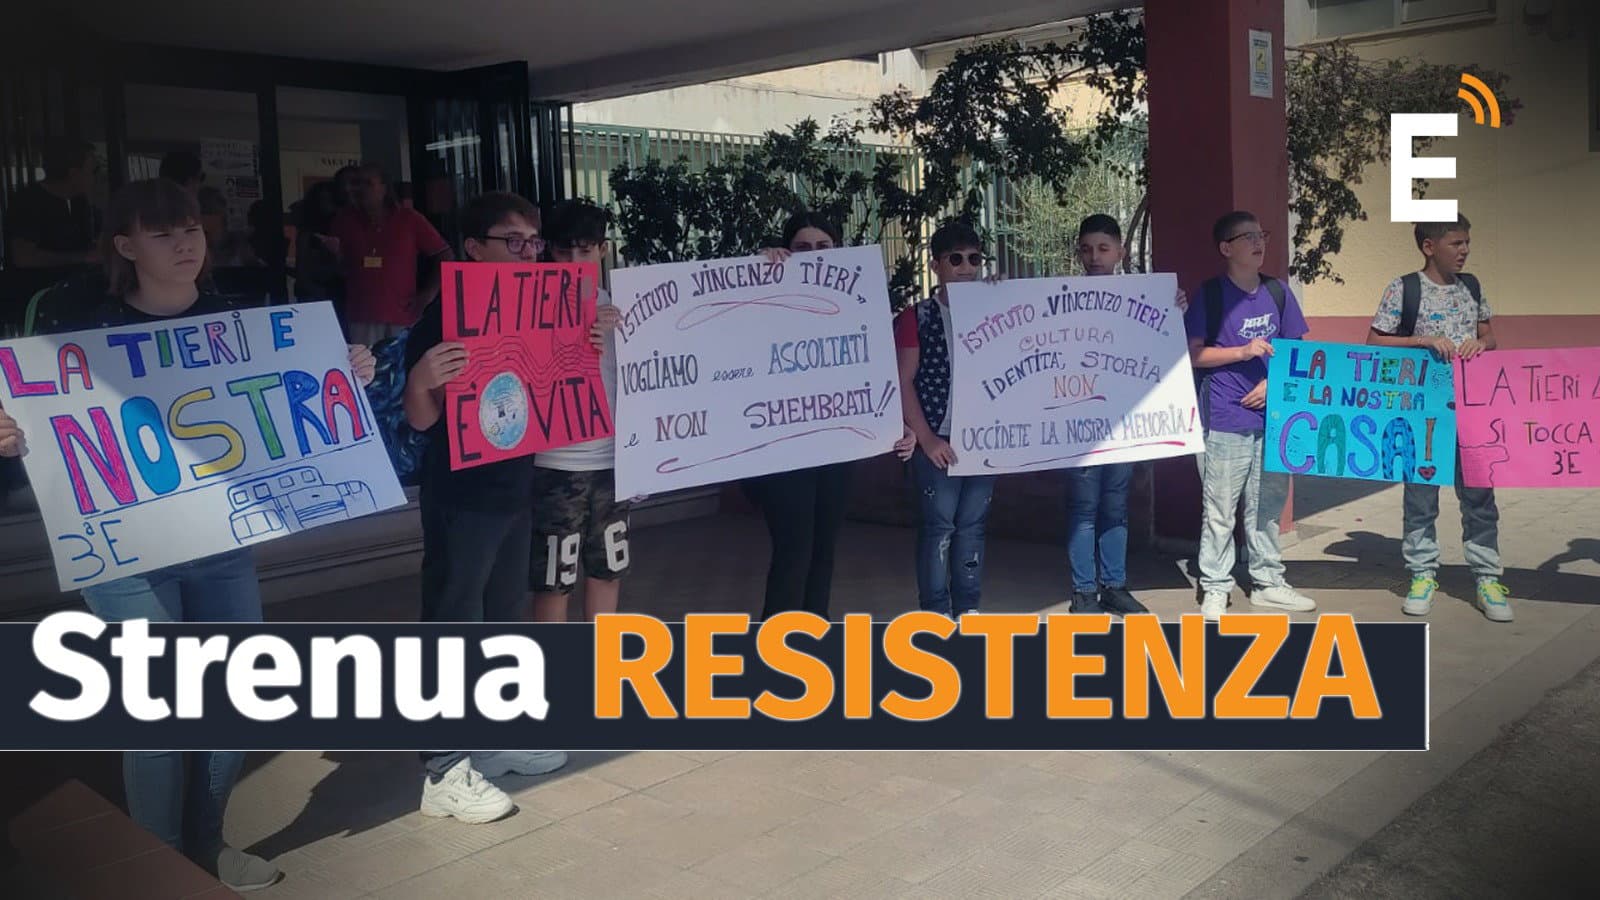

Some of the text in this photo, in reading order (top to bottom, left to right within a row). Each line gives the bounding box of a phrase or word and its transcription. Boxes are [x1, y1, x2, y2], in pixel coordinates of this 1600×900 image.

[455, 268, 583, 338] LA TIERI
[618, 279, 679, 344] ISTITUTO
[957, 303, 1035, 354] ISTITUTO
[0, 343, 94, 398] LA
[107, 311, 251, 378] TIERI
[620, 324, 870, 396] VOGLIAMO essere ASCOLTATI
[1019, 327, 1114, 352] CULTURA
[1053, 373, 1099, 399] NON
[1080, 351, 1161, 383] STORIA
[1288, 347, 1429, 387] LA TIERI
[1461, 358, 1516, 407] LA
[1521, 365, 1580, 403] TIERI
[528, 377, 610, 443] VITA
[623, 380, 897, 448] e NON SMEMBRATI!!
[1308, 385, 1332, 406] LA
[1340, 386, 1425, 411] NOSTRA
[50, 368, 375, 516] NOSTRA!
[962, 403, 1195, 451] UCCIDETE LA NOSTRA MEMORIA!
[1279, 410, 1437, 482] CASA!
[1486, 418, 1593, 445] SI TOCCA
[545, 532, 581, 586] 19
[604, 520, 630, 573] 6
